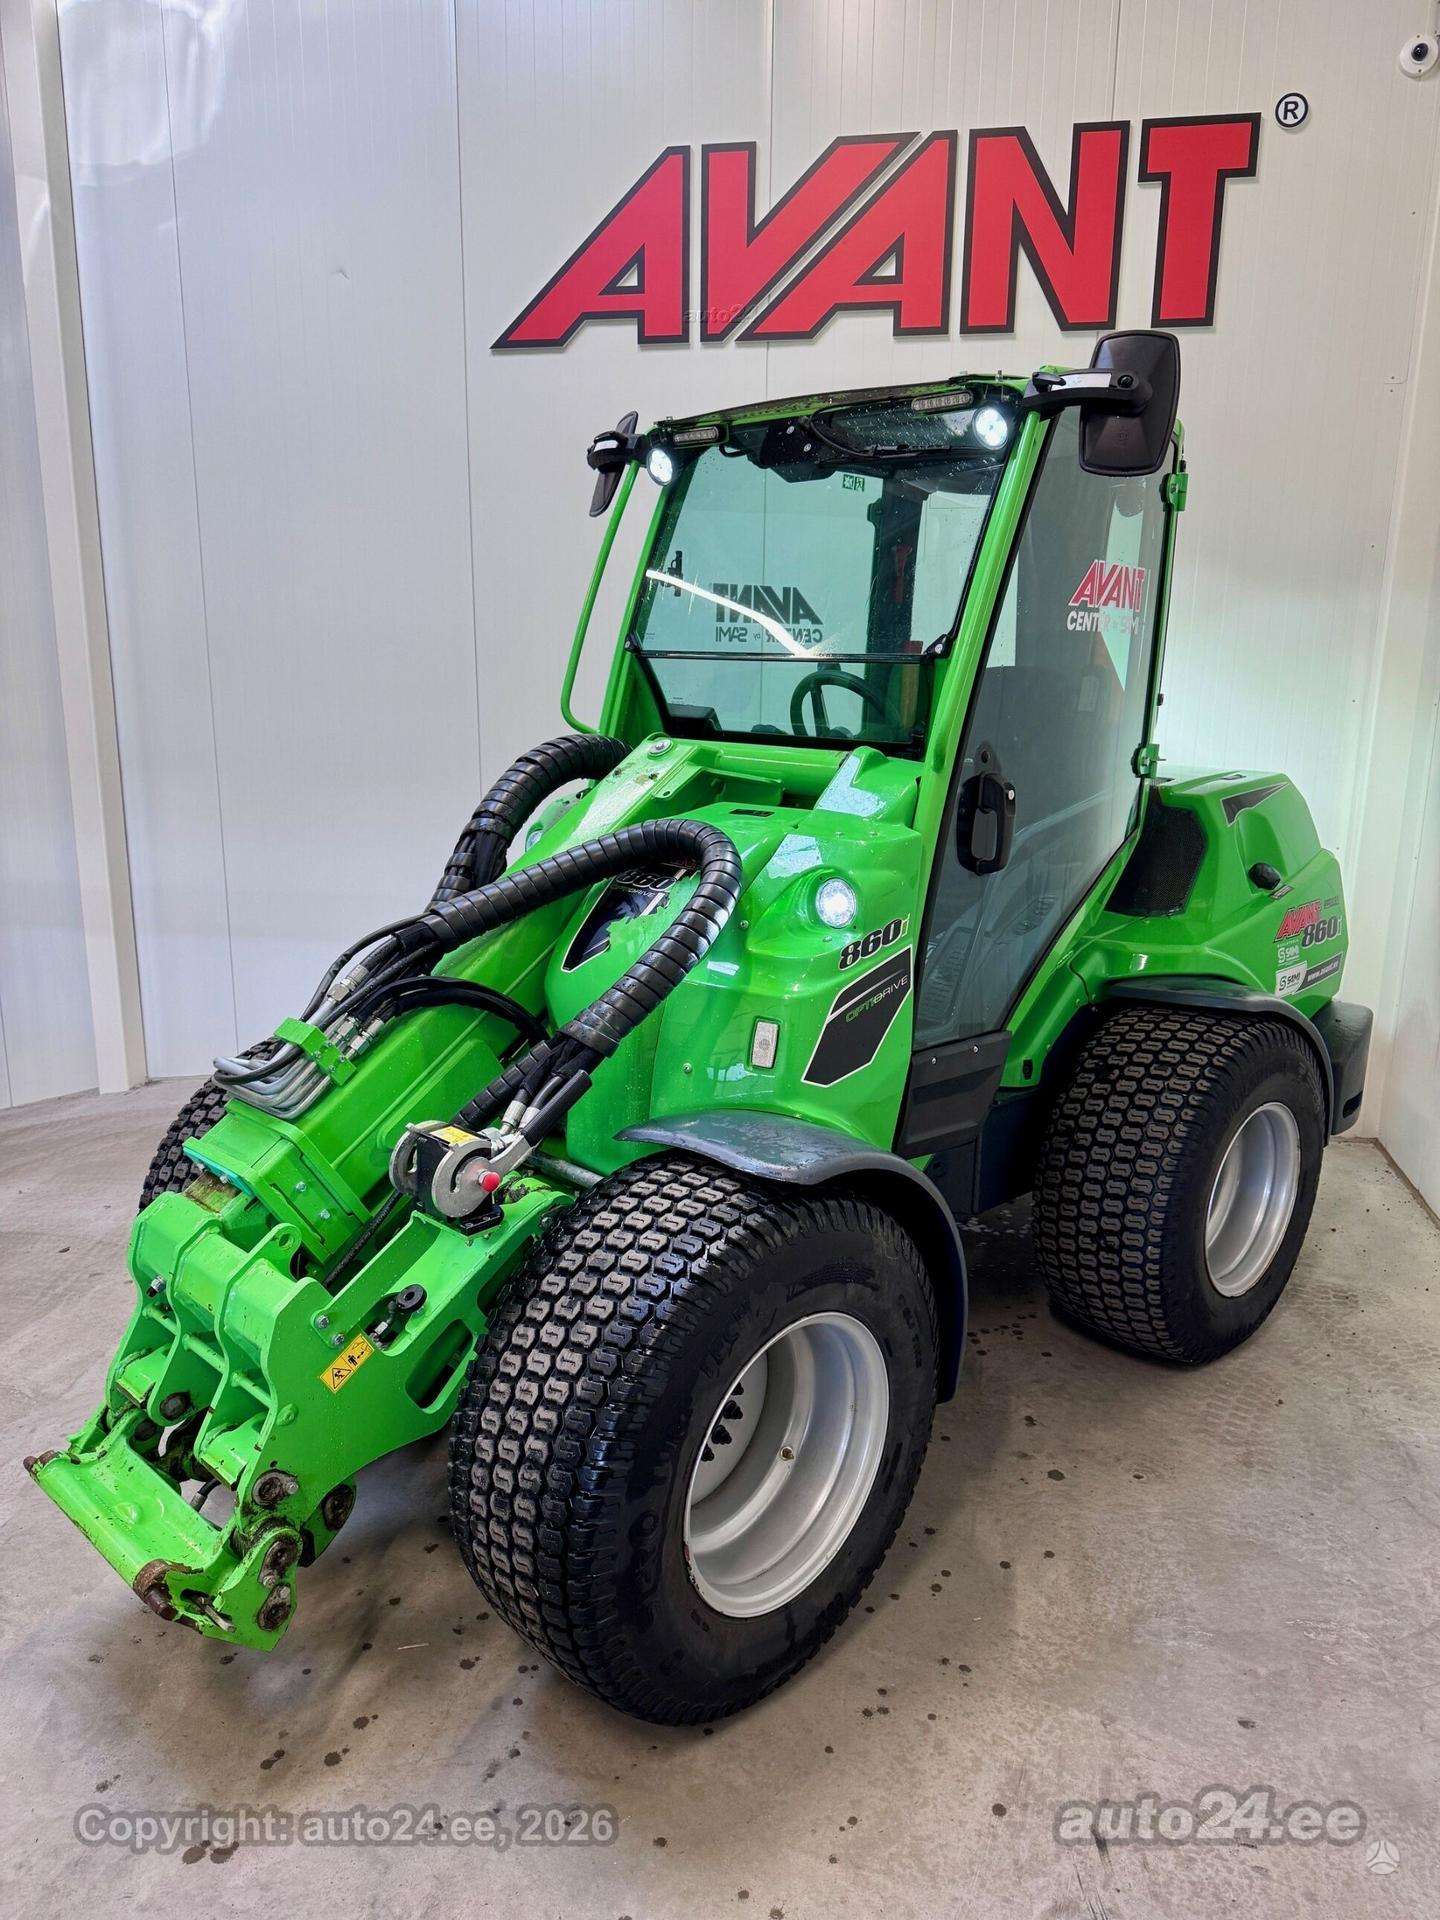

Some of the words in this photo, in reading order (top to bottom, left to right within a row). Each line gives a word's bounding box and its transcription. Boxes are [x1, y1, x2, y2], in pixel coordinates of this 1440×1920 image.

[491, 112, 1262, 351] AVANT
[1067, 559, 1145, 613] AVANT
[845, 974, 908, 1023] OPTIDRIVE
